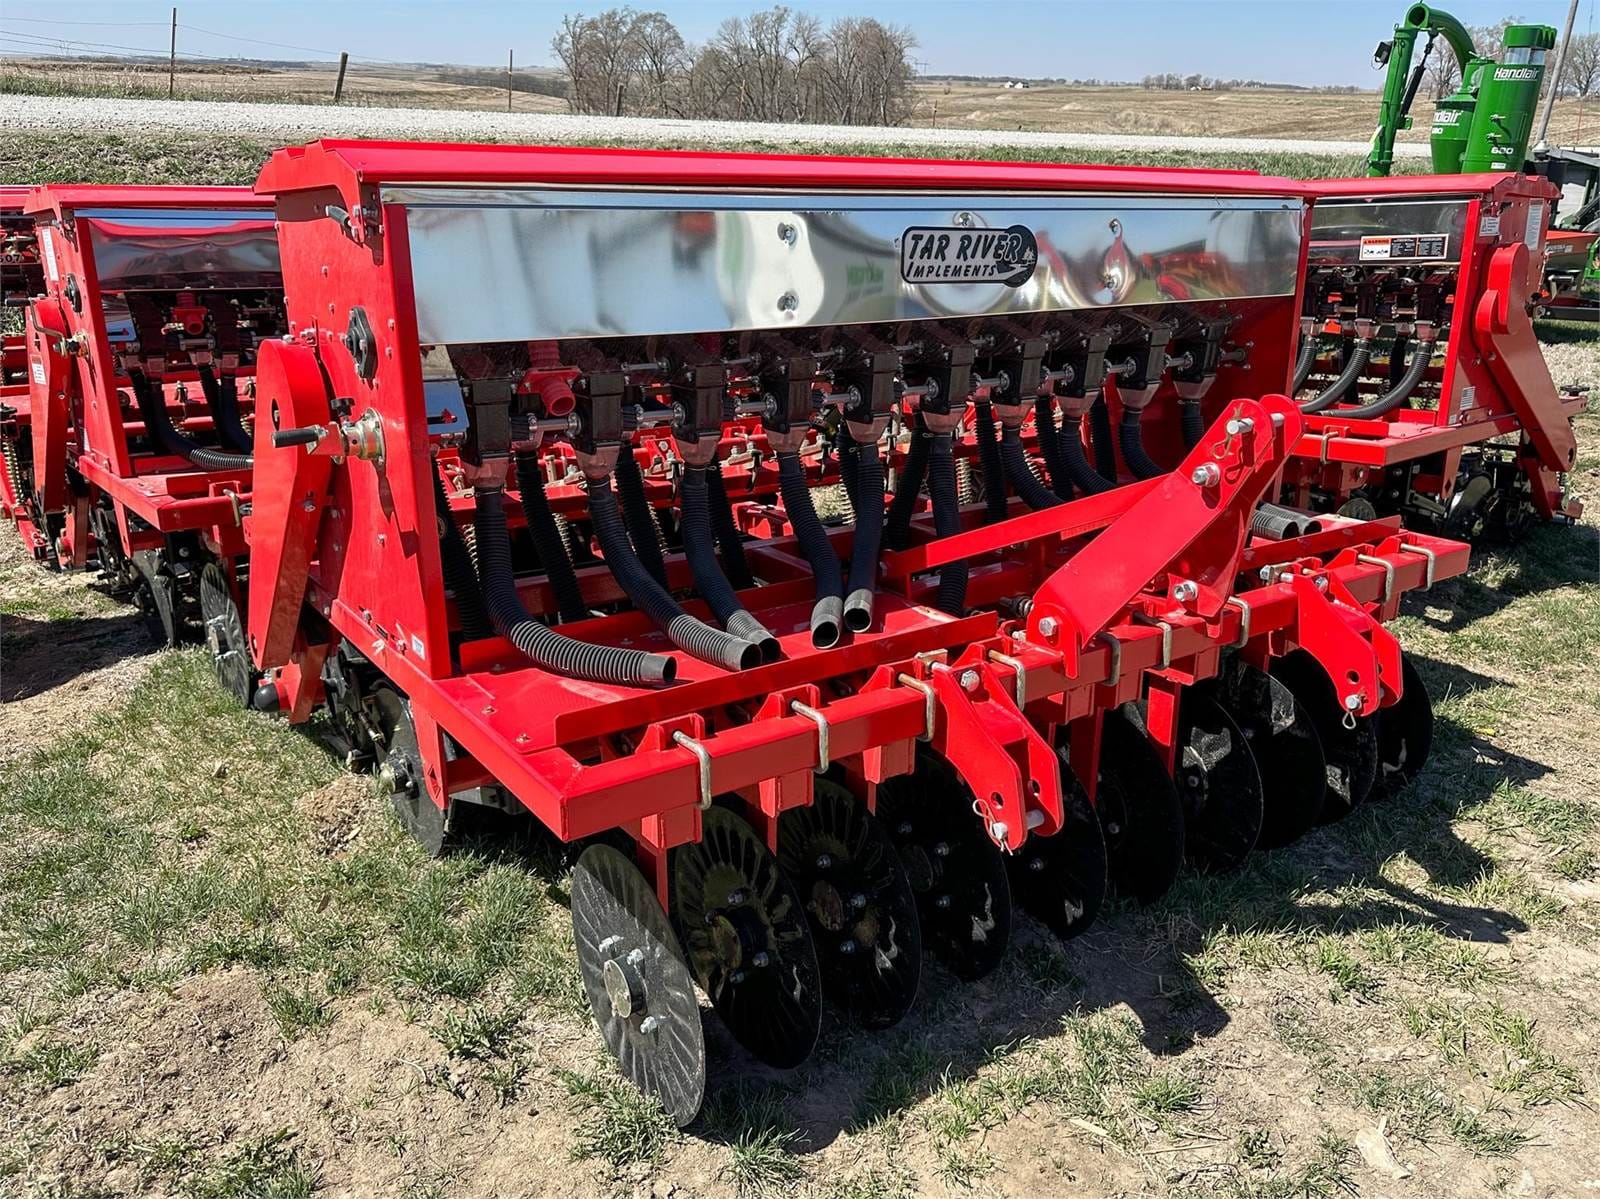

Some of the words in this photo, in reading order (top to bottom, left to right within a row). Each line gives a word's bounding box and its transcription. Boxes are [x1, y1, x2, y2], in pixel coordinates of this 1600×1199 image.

[1494, 68, 1539, 78] Handlair
[909, 234, 950, 262] TAR
[956, 233, 1022, 263] RIVER
[906, 261, 997, 278] IMPLEMENTS
